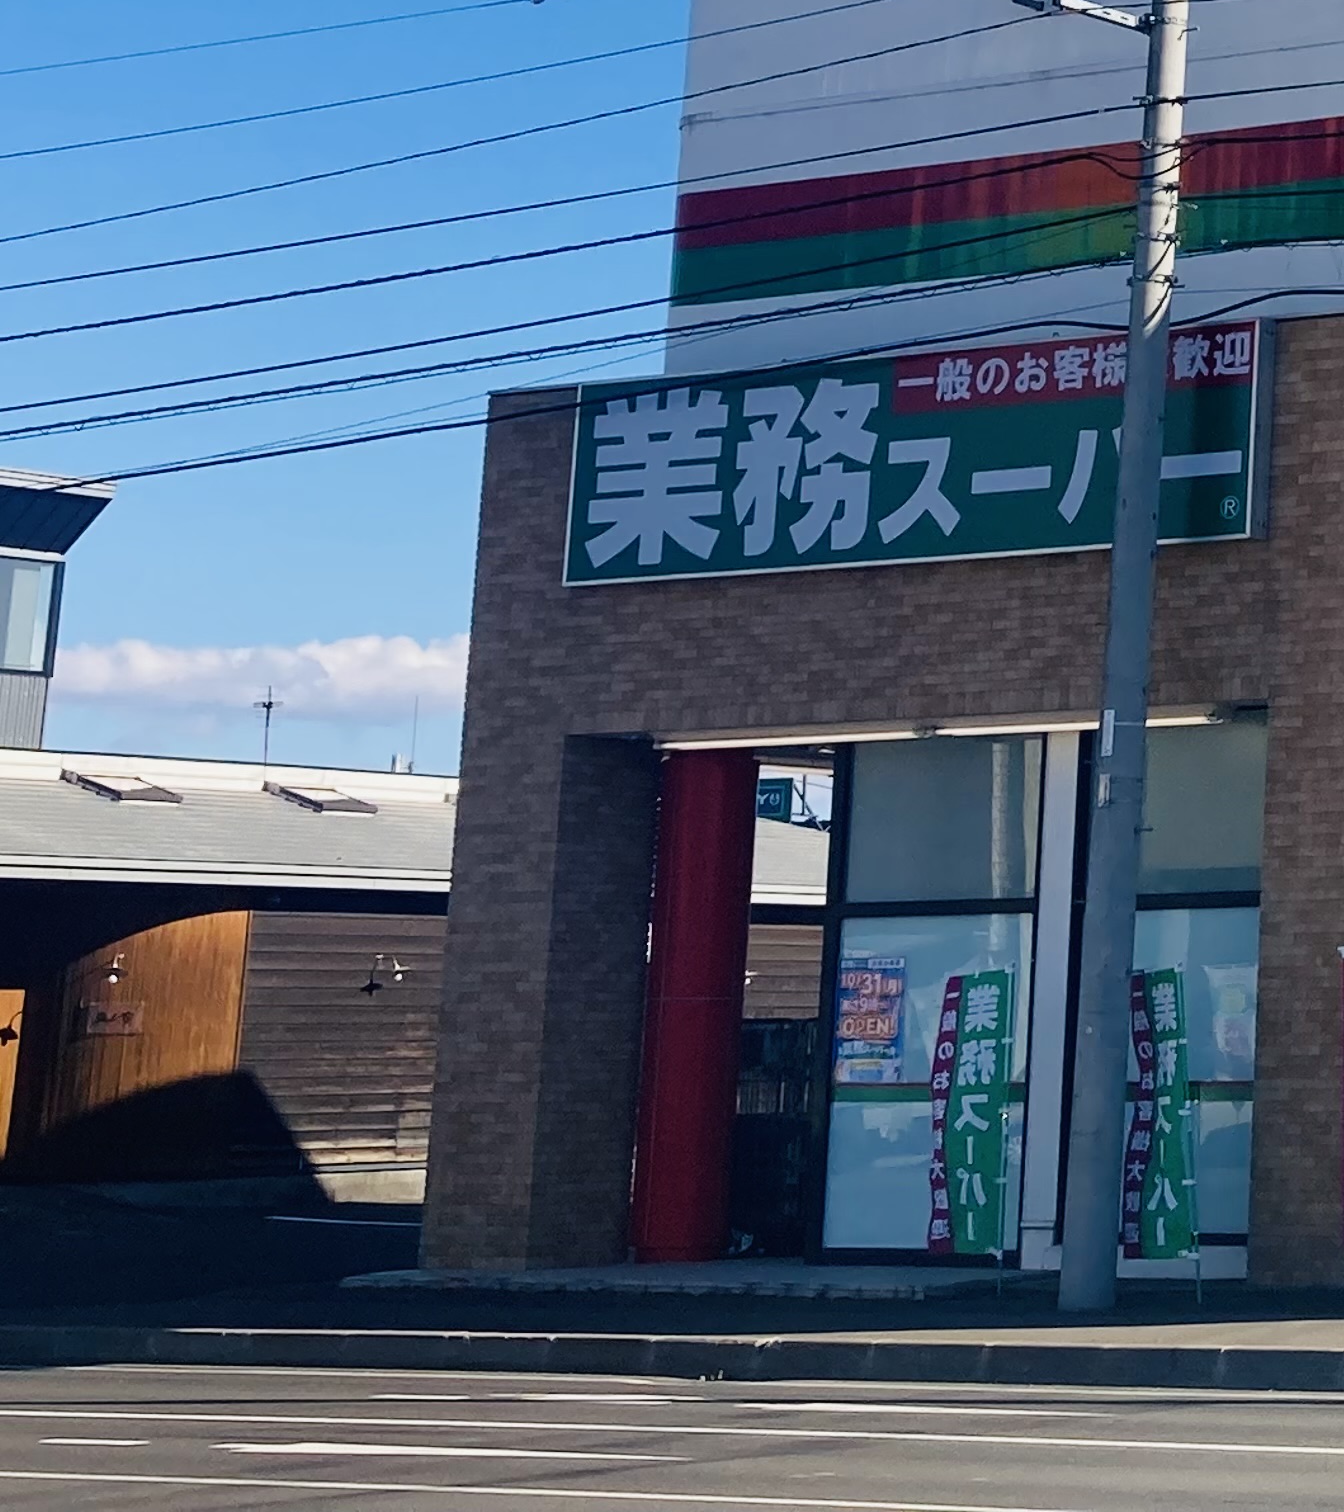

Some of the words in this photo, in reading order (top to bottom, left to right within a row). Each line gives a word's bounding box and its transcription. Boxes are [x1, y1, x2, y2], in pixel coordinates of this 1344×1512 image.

[898, 331, 1251, 402] 一般のお客様歓迎
